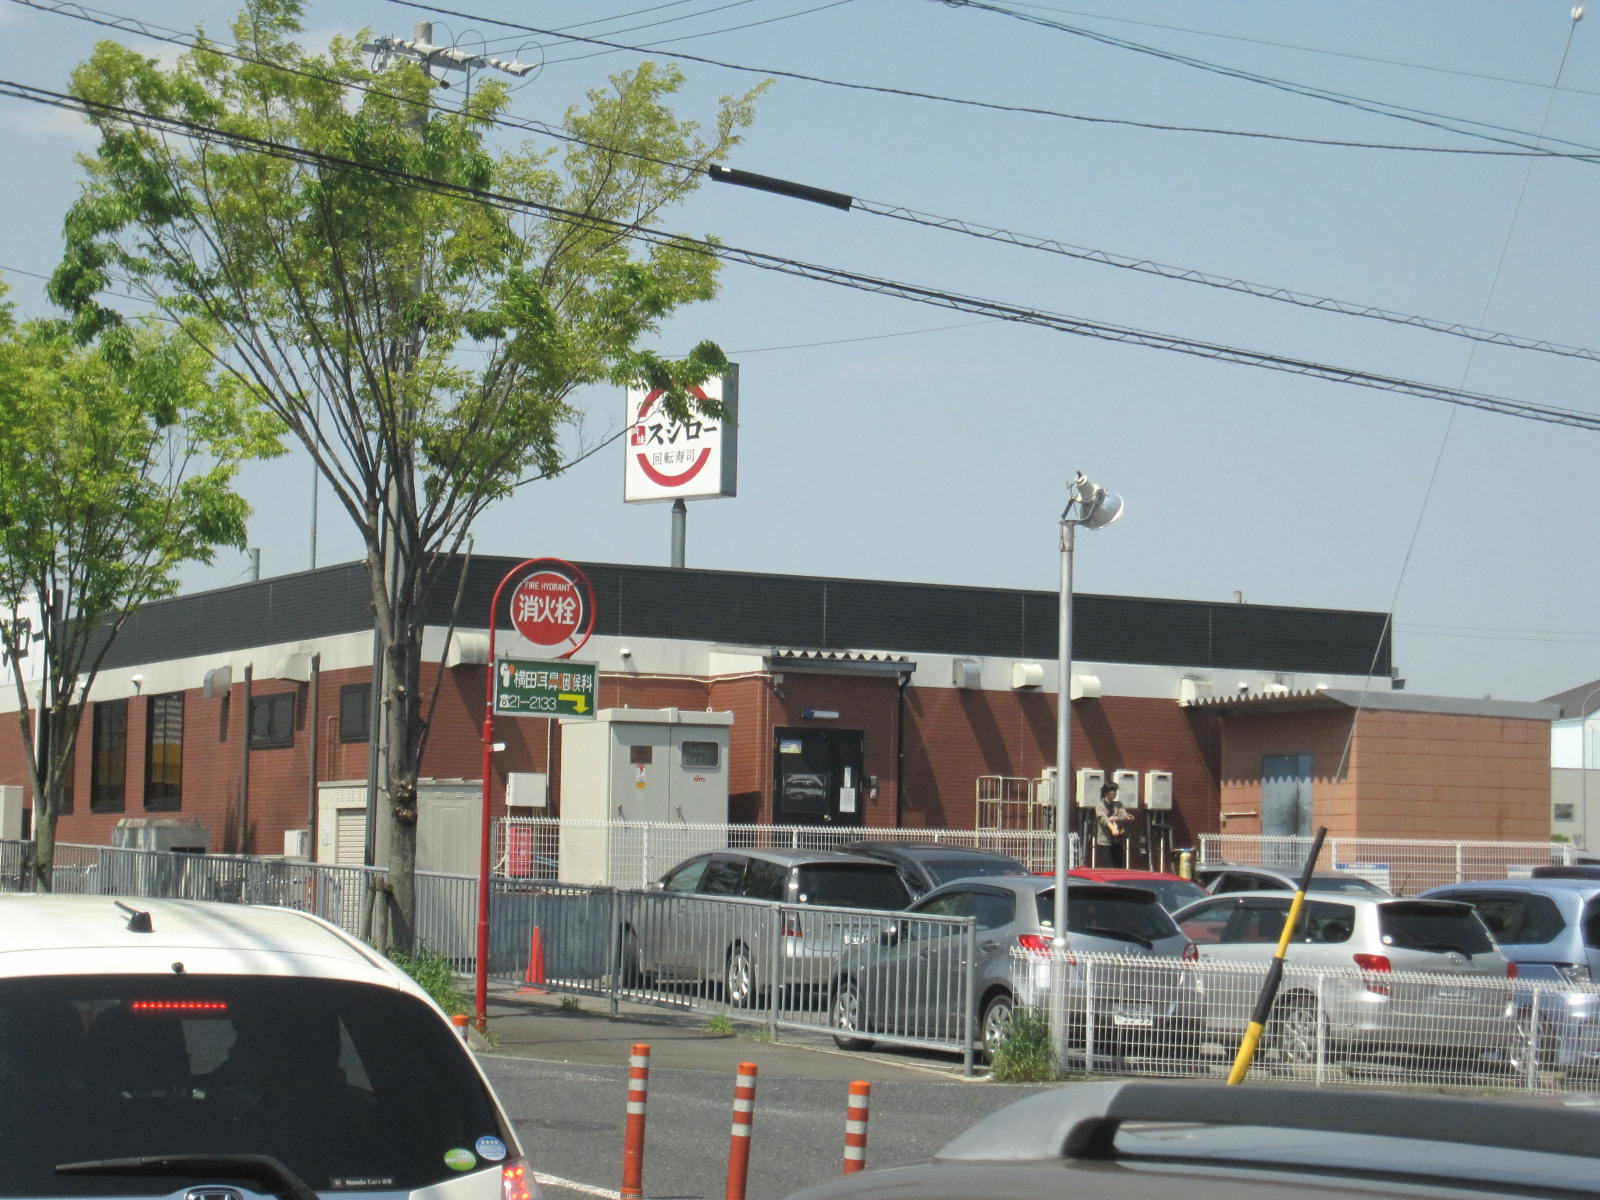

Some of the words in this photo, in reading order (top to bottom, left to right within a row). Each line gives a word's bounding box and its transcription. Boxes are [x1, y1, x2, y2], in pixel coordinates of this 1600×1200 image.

[646, 419, 718, 446] スシロー
[653, 449, 695, 466] 回転寿司
[524, 582, 540, 590] FIRE
[541, 583, 570, 592] HYDRANT
[518, 594, 577, 625] 消火栓
